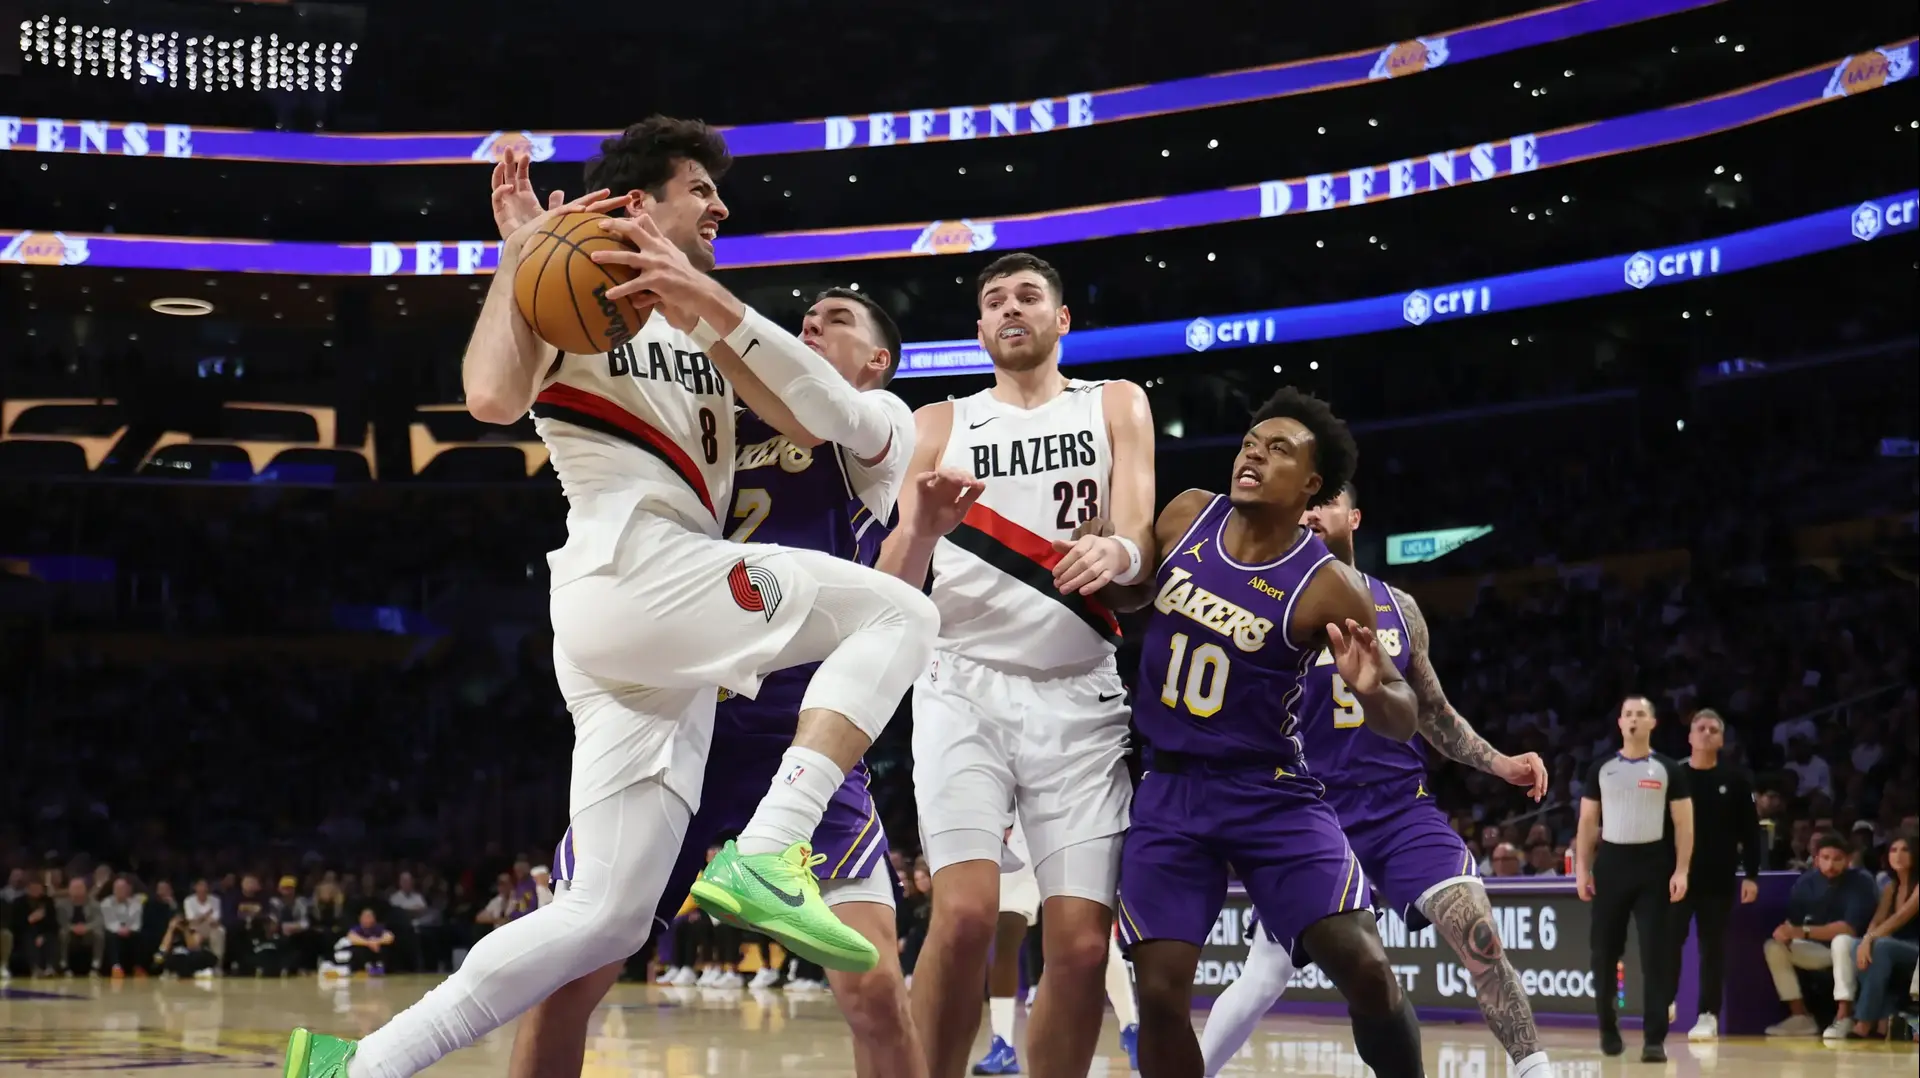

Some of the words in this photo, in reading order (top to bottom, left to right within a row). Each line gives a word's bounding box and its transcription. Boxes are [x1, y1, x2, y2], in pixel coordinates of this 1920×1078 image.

[0, 116, 193, 158] FENSE
[824, 92, 1095, 150] DEFENSE
[1259, 133, 1539, 218] DEFENSE
[1885, 199, 1919, 226] cr
[370, 241, 504, 275] DEF
[607, 342, 725, 397] BLAERS
[699, 407, 718, 464] 8
[735, 434, 814, 474] KERS
[970, 430, 1096, 479] BLAZERS
[1053, 479, 1098, 530] 23
[1154, 566, 1274, 652] LAKERS
[1247, 575, 1285, 601] Albert
[1160, 632, 1231, 718] 10
[1332, 673, 1365, 729] 5
[1492, 906, 1534, 950] ME
[1539, 906, 1557, 950] 6
[1514, 968, 1597, 998] eacoc
